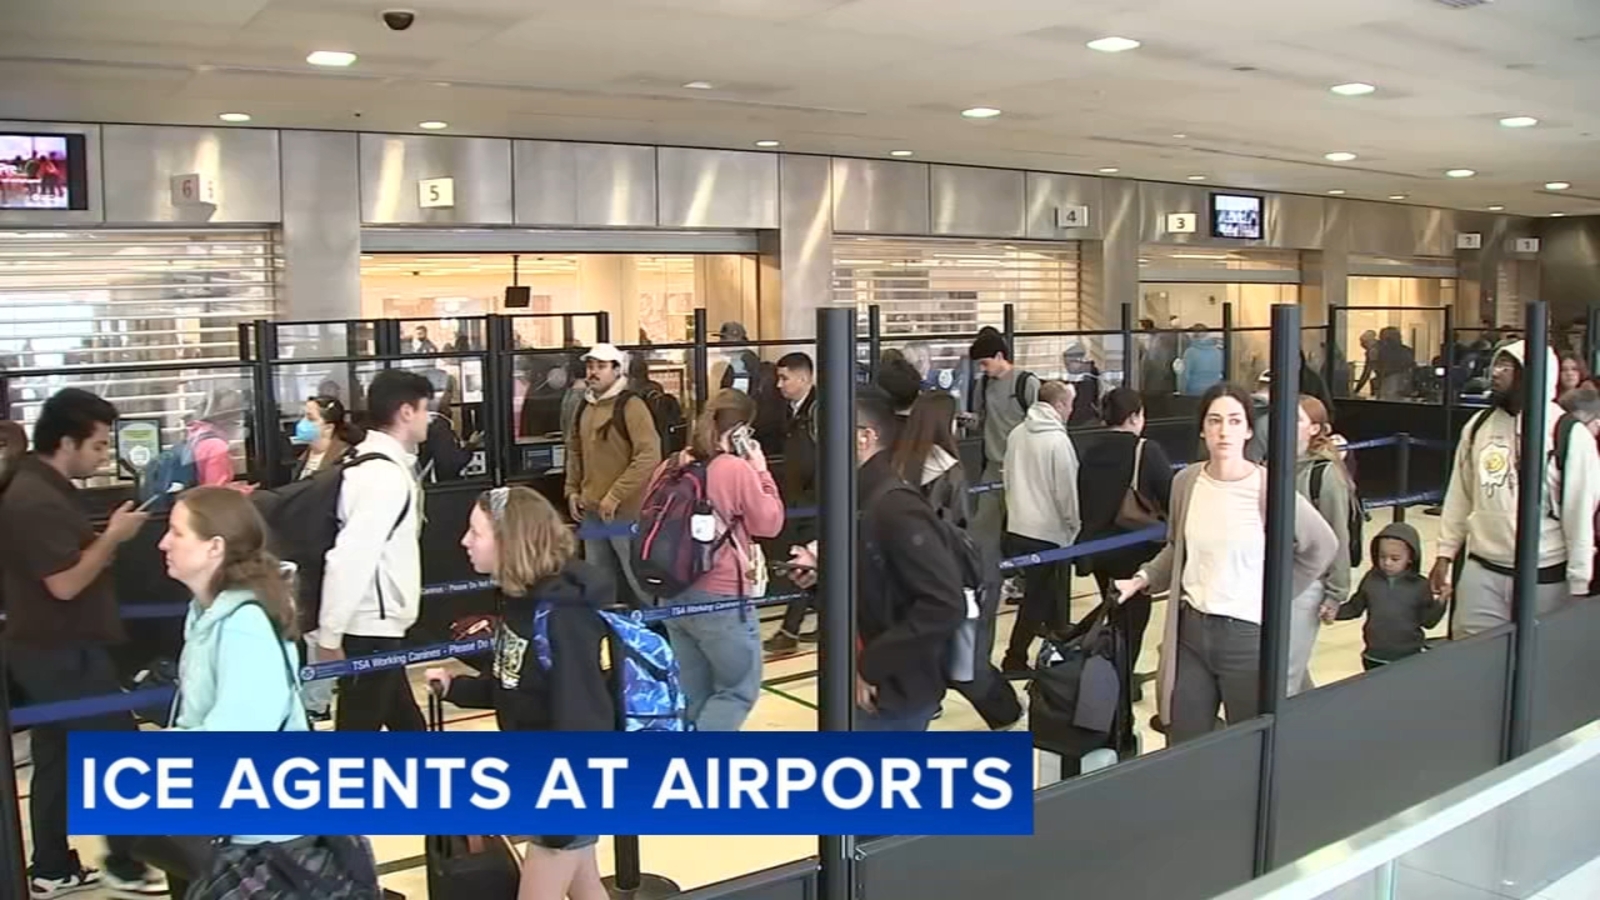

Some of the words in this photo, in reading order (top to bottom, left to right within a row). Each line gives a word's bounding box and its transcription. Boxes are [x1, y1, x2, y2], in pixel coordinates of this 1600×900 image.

[182, 179, 192, 199] 6
[429, 185, 440, 202] 5
[1066, 210, 1077, 223] 4
[1176, 217, 1186, 229] 3
[671, 606, 686, 616] TSA
[352, 660, 371, 671] TSA
[372, 654, 407, 668] Working
[408, 649, 441, 662] Canines
[449, 643, 476, 655] Please
[477, 639, 489, 649] Do
